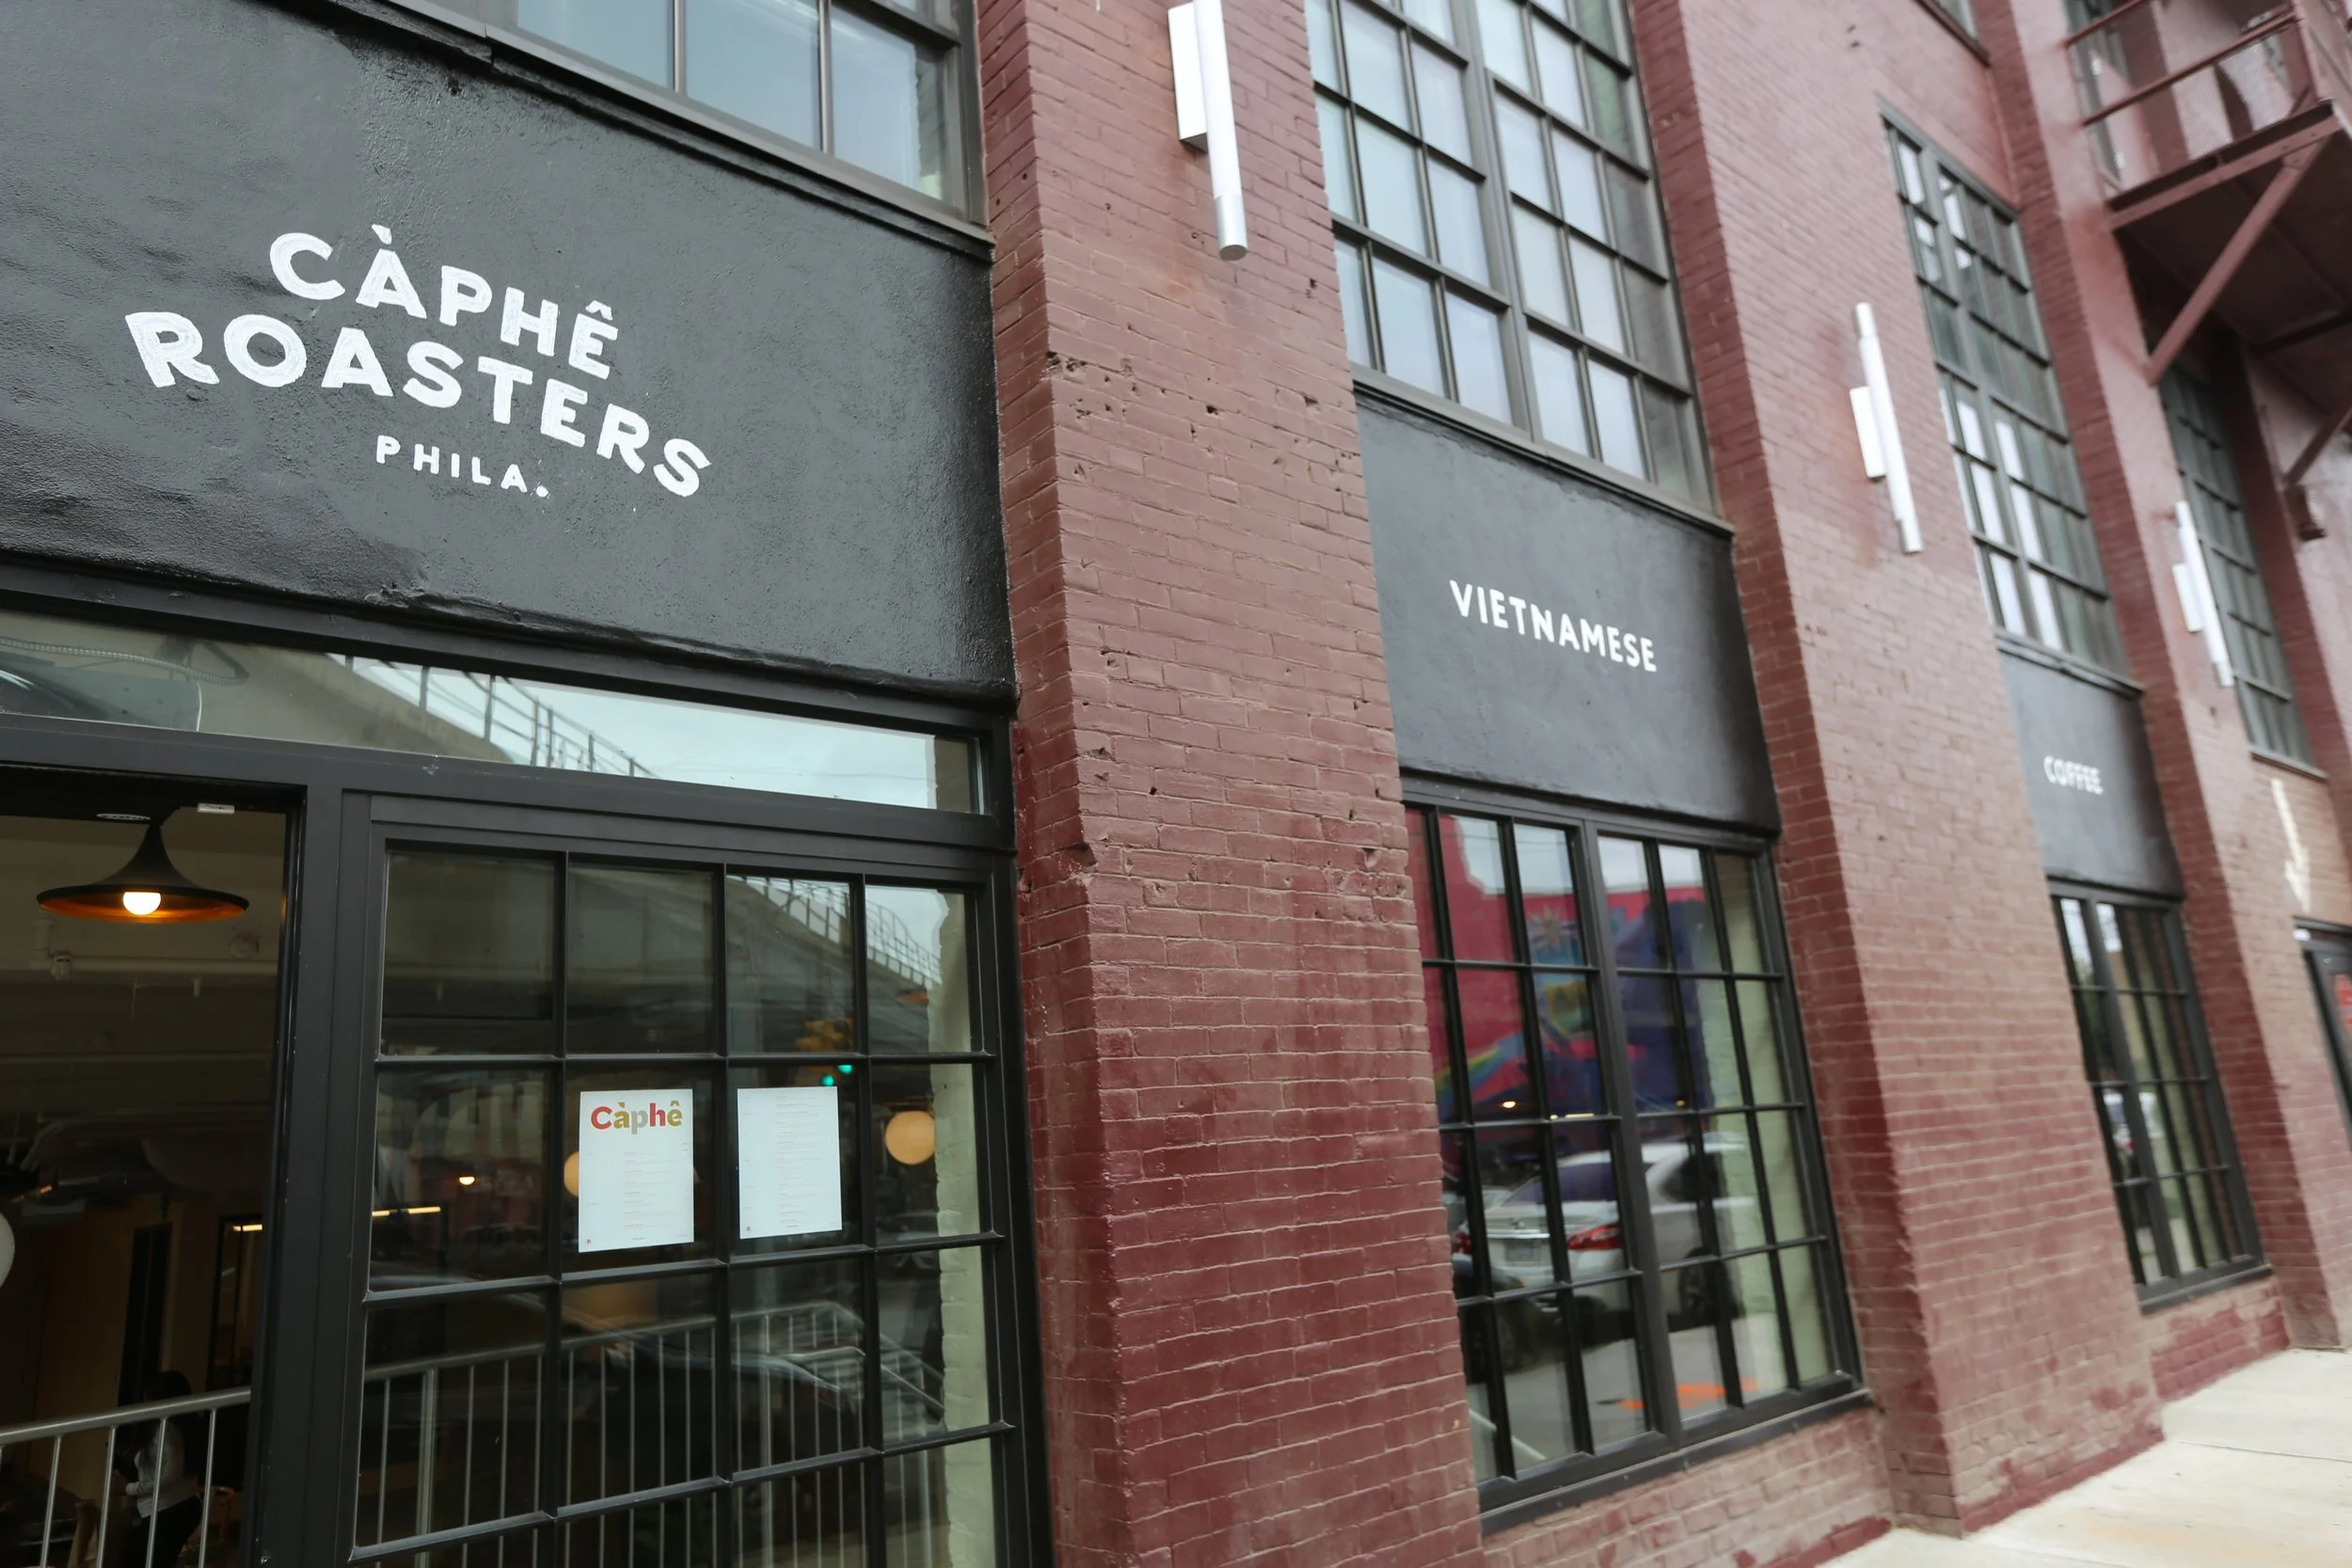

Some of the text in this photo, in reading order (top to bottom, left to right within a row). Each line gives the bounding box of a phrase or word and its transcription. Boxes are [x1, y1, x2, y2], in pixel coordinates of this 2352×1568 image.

[269, 224, 619, 380] CÀPHÊ
[124, 311, 711, 498] ROASTERS
[375, 435, 549, 499] PHILA.
[1449, 578, 1658, 673] VIETNAMESE
[2042, 754, 2105, 796] COFFEE
[590, 1100, 683, 1135] Càphê
